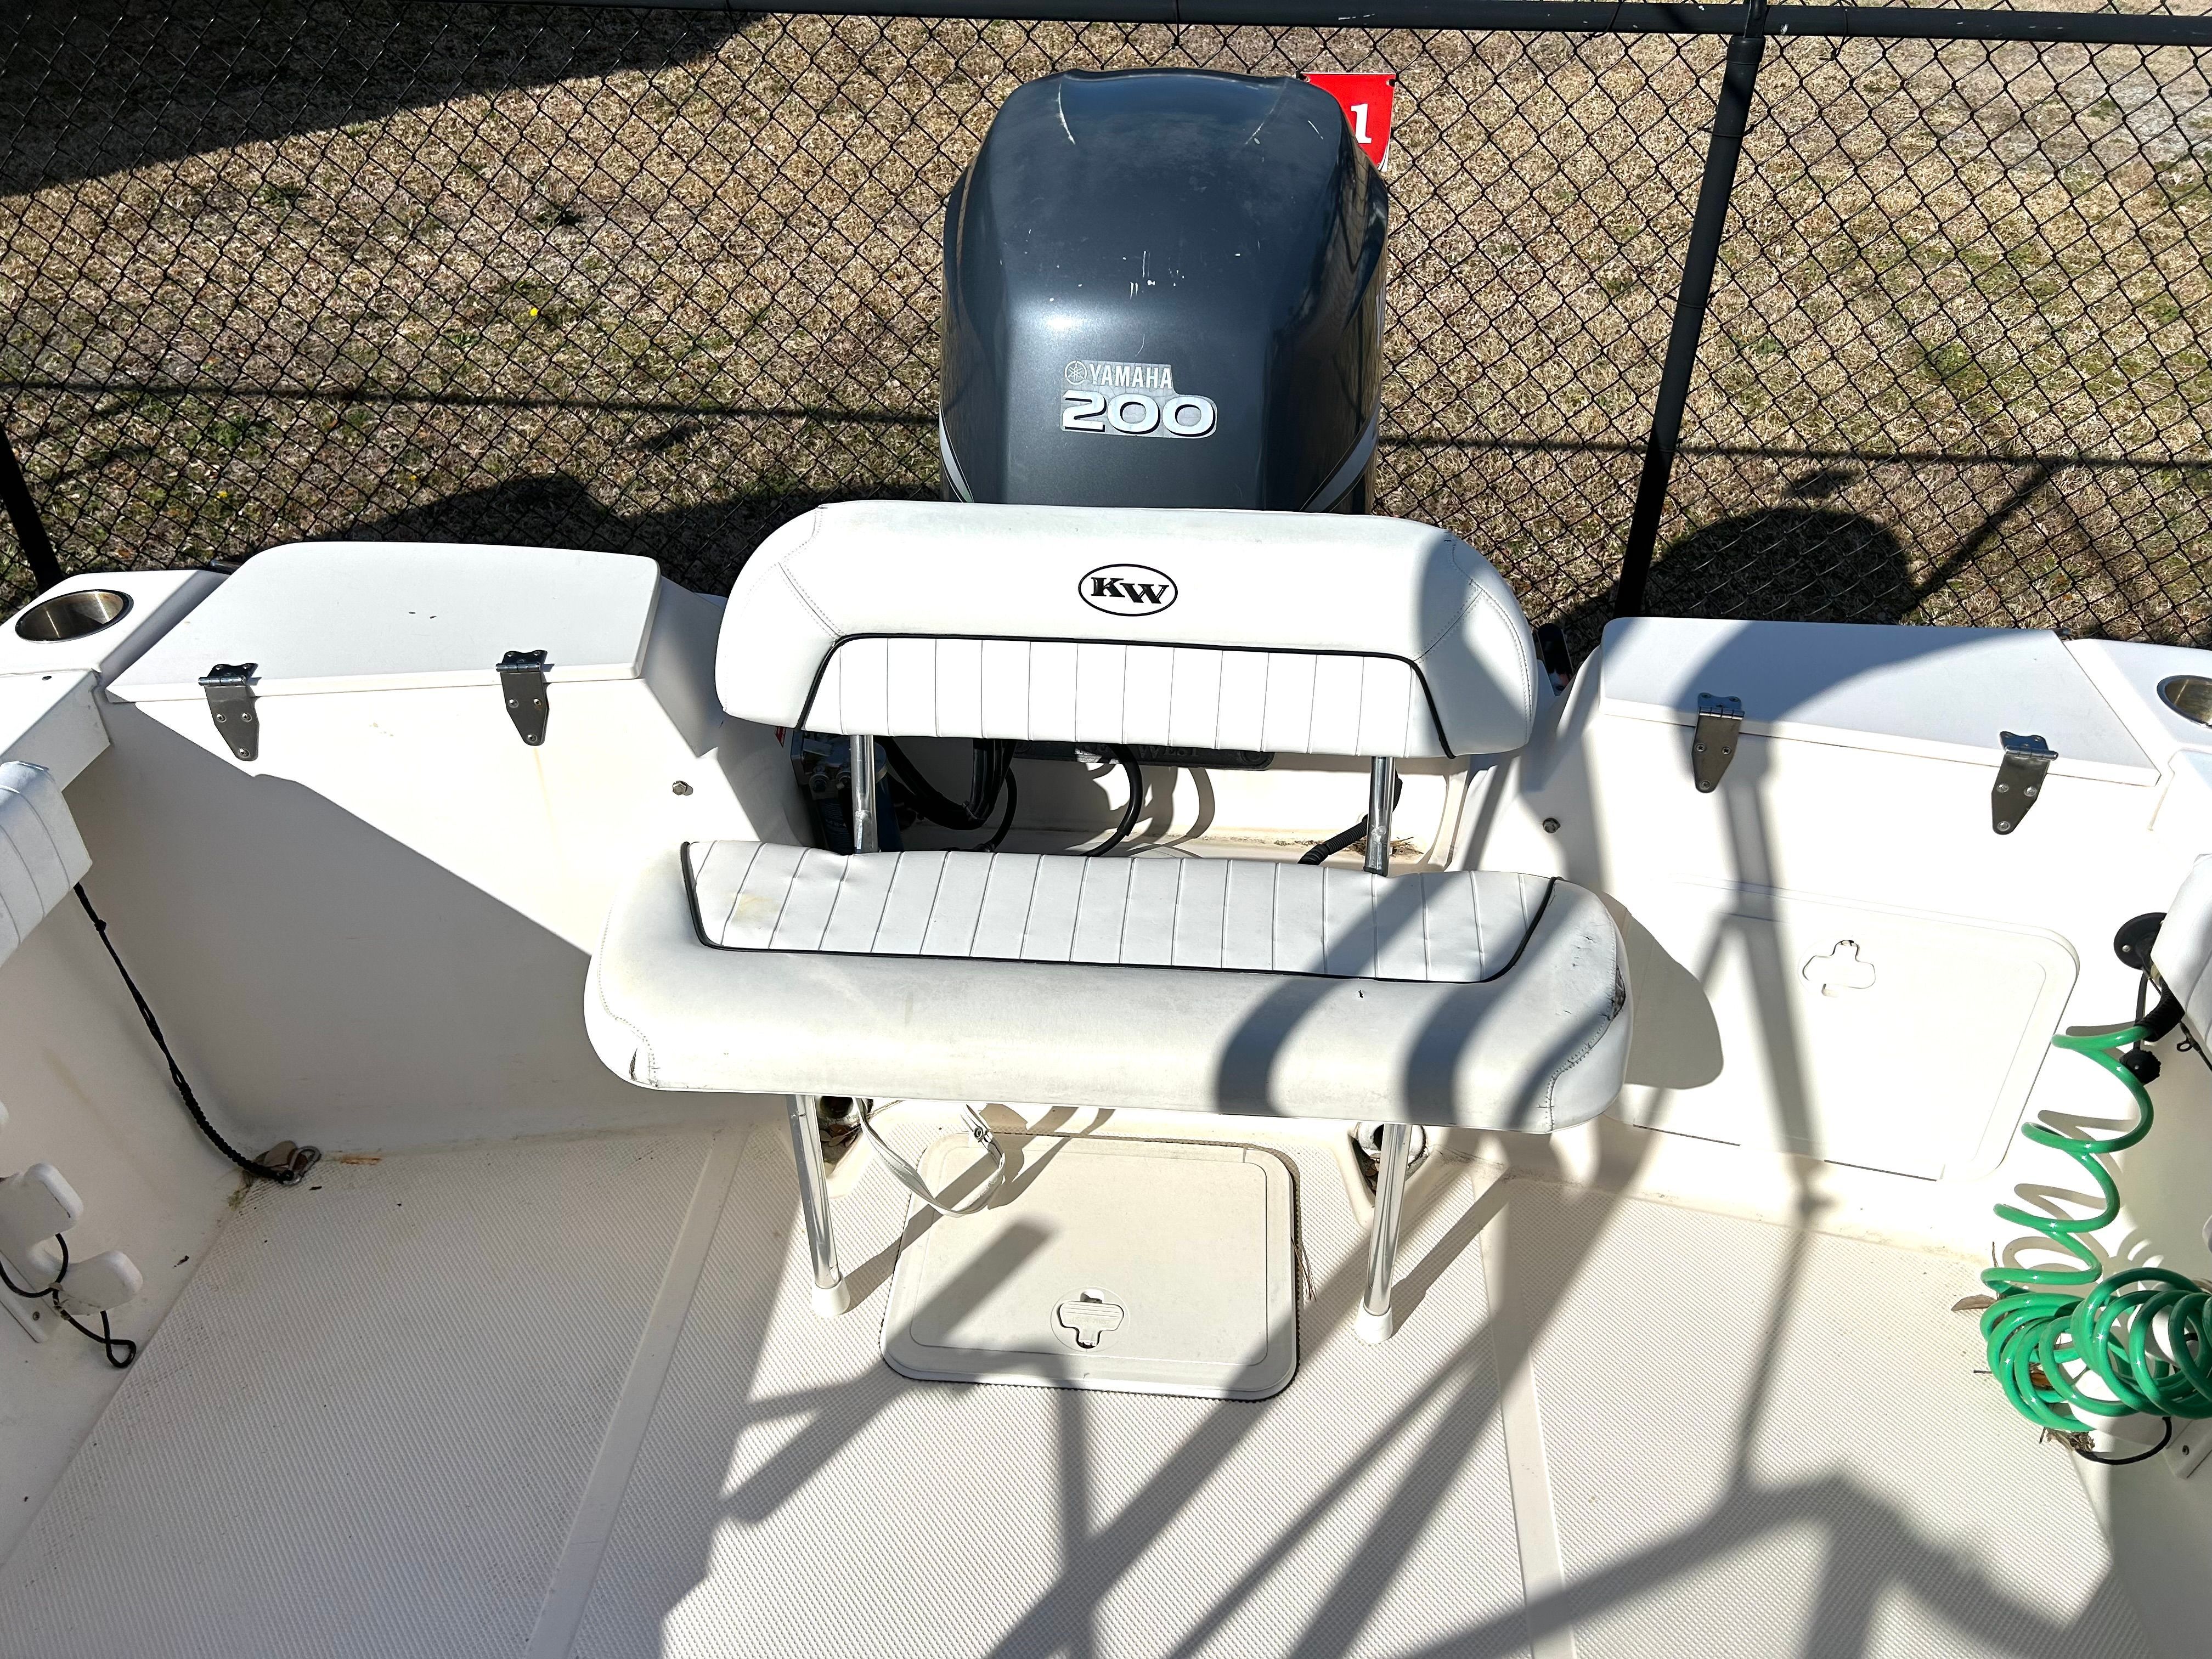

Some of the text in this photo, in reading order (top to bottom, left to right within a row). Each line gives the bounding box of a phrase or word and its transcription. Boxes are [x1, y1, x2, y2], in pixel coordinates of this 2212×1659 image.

[1089, 363, 1172, 389] YAMAHA
[1062, 390, 1216, 437] 200
[1091, 577, 1170, 604] KW
